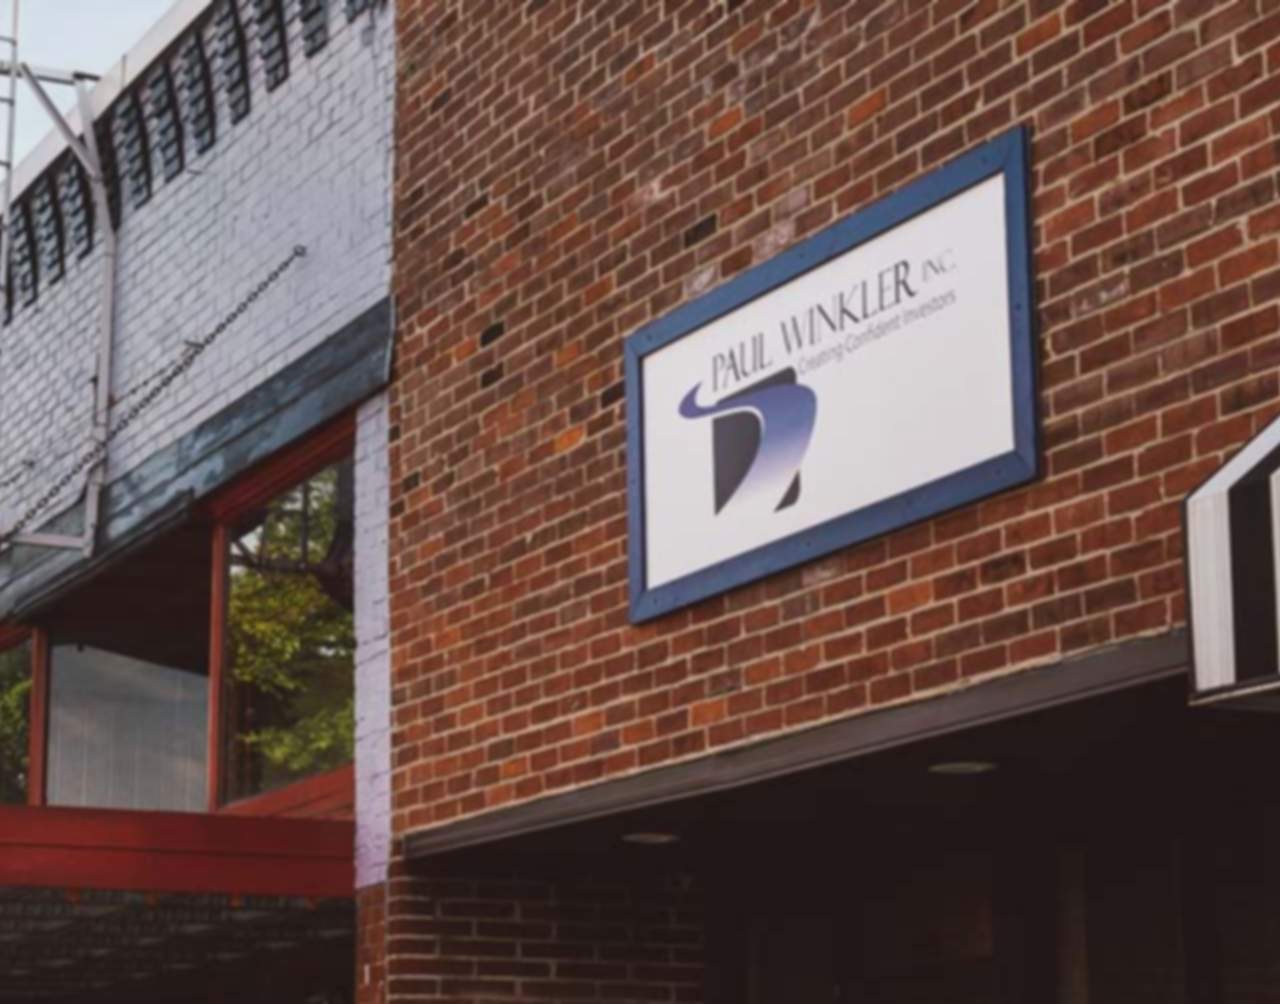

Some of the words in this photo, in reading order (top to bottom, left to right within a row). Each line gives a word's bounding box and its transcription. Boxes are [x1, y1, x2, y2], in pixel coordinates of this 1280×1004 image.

[712, 331, 773, 393] PAUL
[780, 259, 917, 354] WINKLER
[798, 343, 844, 376] Creating
[845, 314, 901, 353] Confident
[903, 289, 957, 325] Investors
